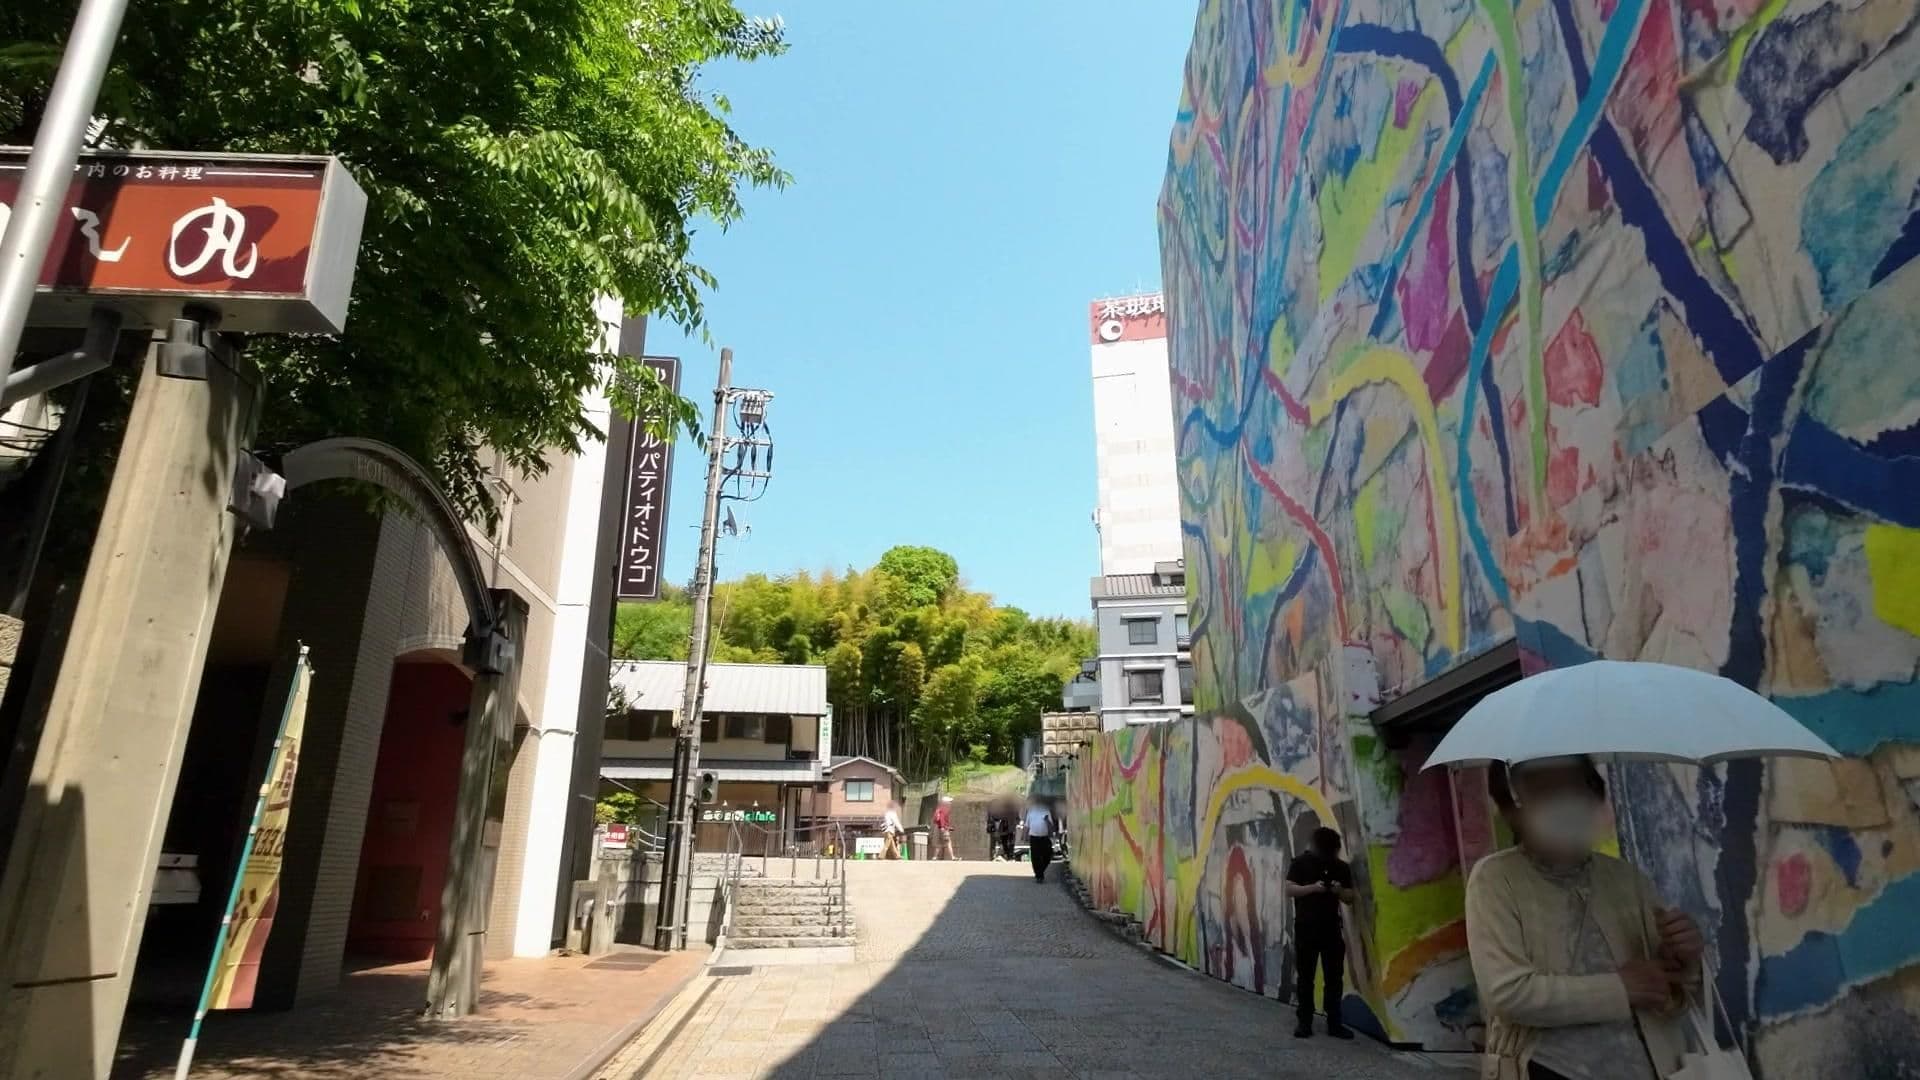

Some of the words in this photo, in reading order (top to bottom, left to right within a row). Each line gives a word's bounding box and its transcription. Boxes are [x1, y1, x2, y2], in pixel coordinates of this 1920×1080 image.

[74, 163, 203, 181] 内のお料理
